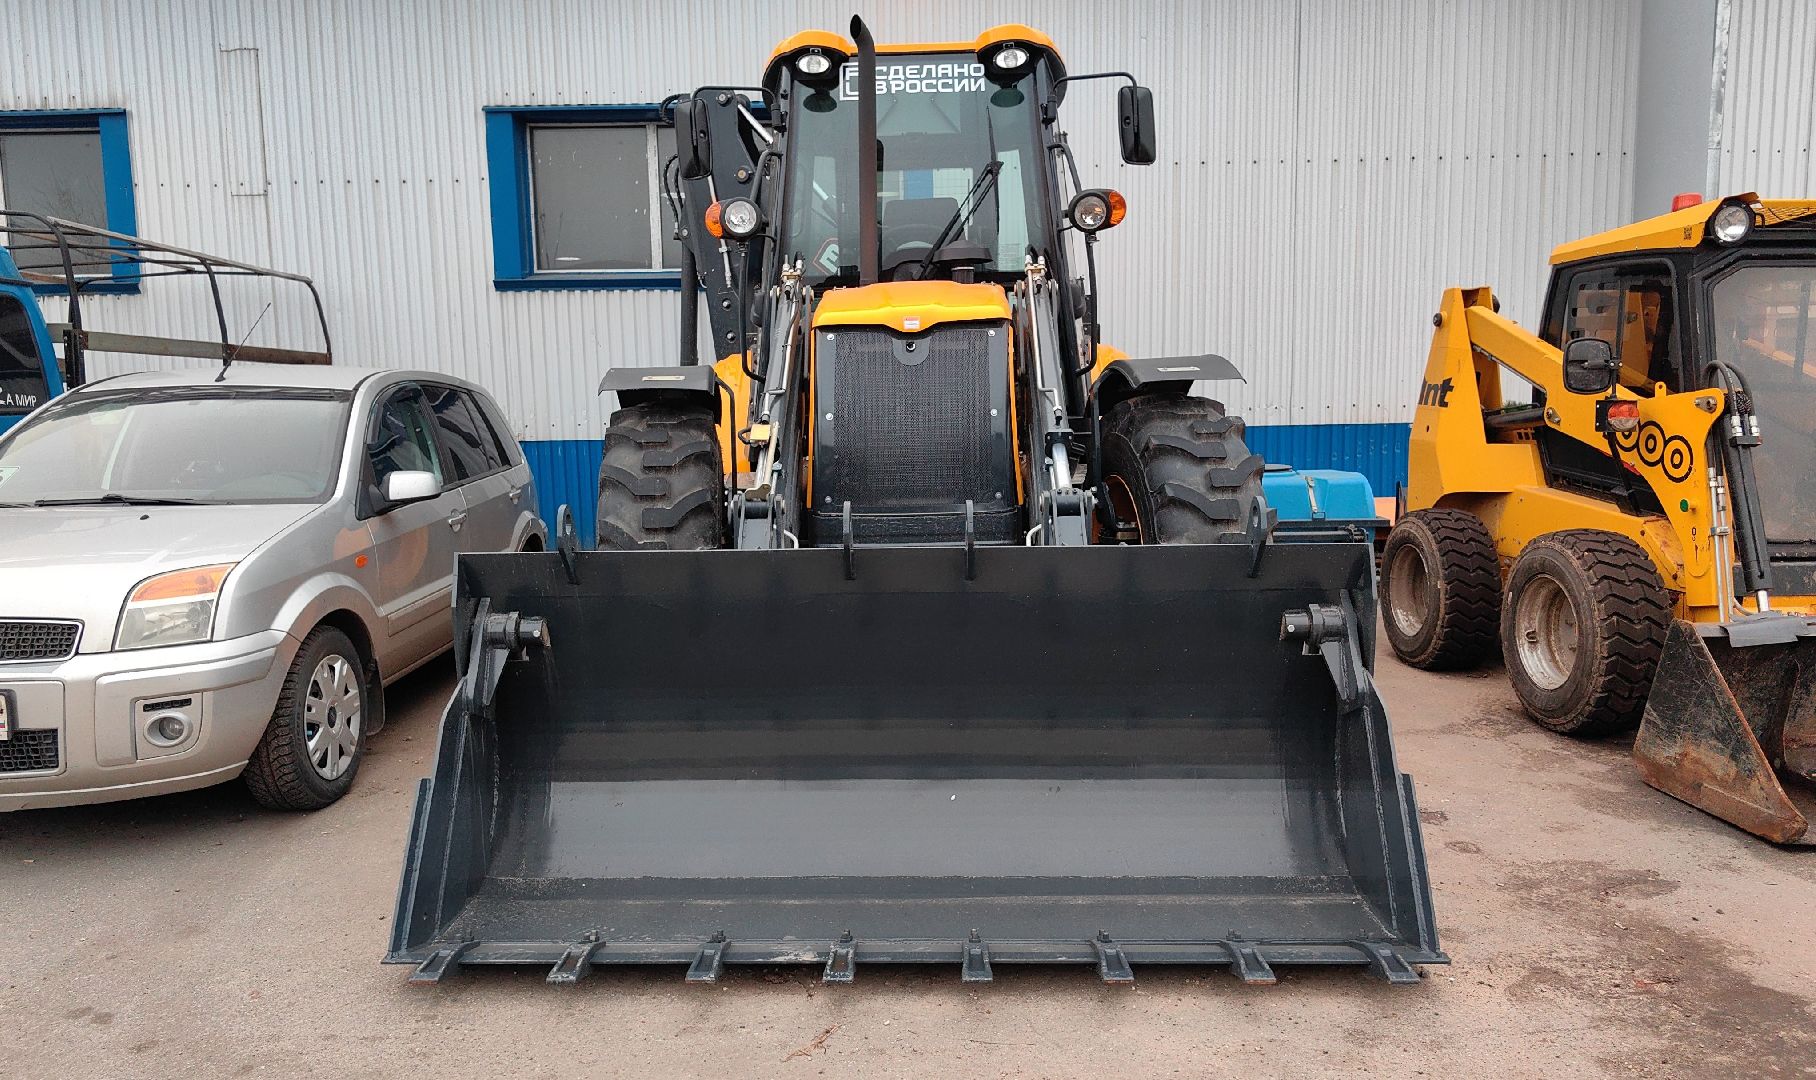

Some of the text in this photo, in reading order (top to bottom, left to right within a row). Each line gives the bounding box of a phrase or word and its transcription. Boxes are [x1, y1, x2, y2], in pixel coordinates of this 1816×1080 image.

[875, 64, 985, 80] СДЕЛАНО
[889, 78, 986, 94] РОССИИ
[15, 394, 37, 407] МИР
